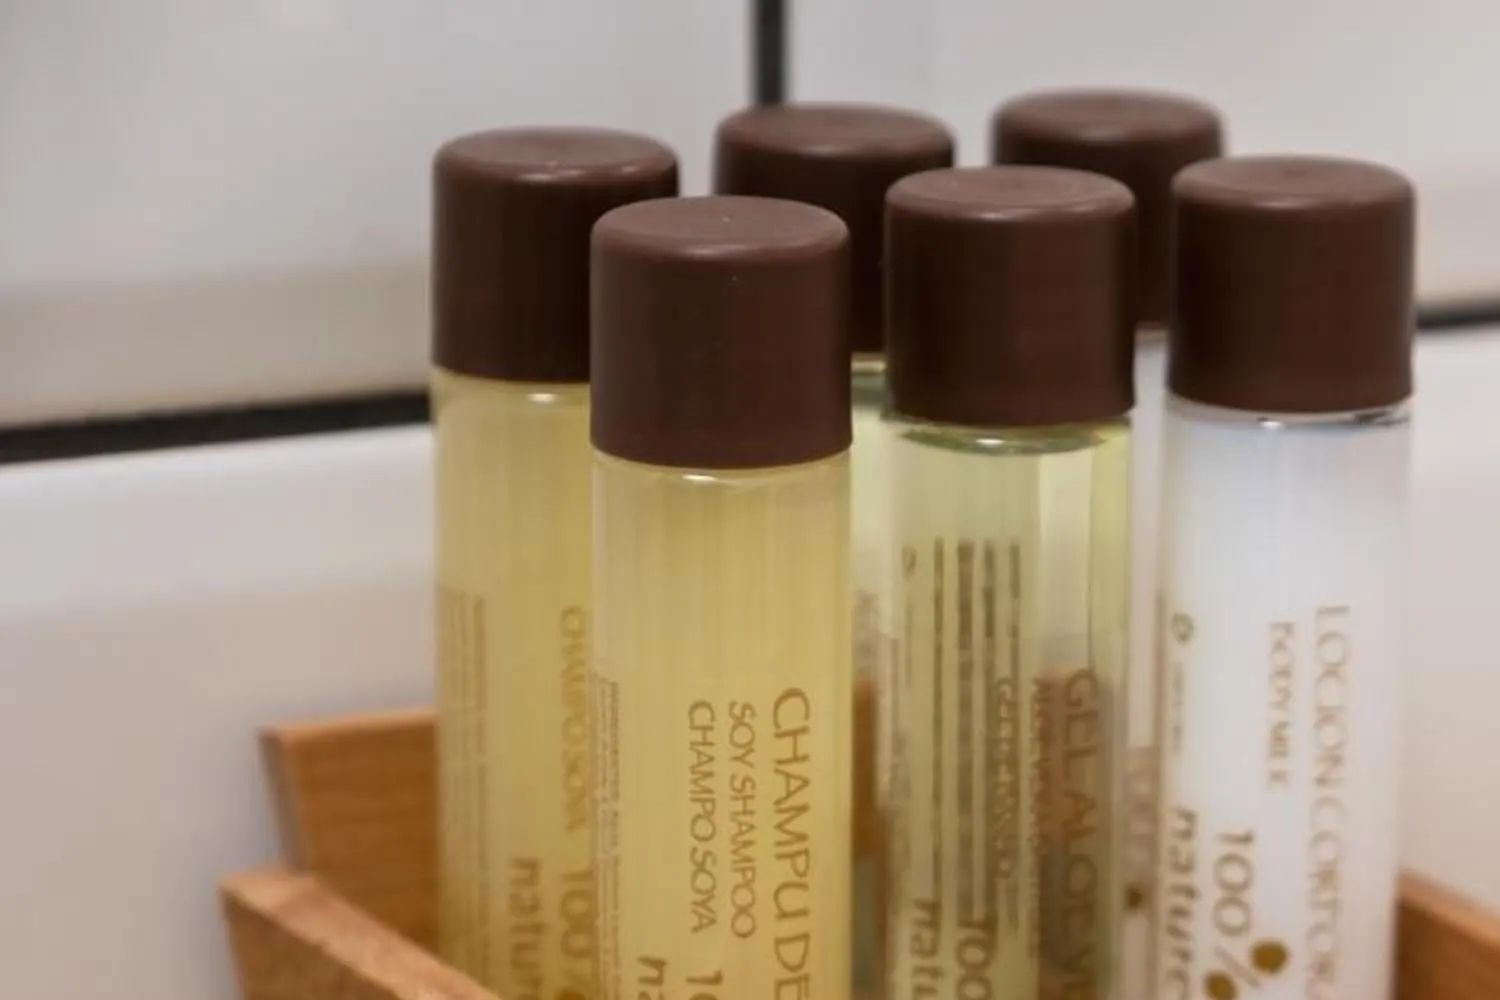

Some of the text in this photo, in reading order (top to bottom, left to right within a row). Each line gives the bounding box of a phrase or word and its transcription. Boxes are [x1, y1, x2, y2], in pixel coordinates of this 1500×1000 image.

[688, 700, 718, 935] CHAMPO SOYA
[727, 700, 758, 940] SOY SHAMPOO
